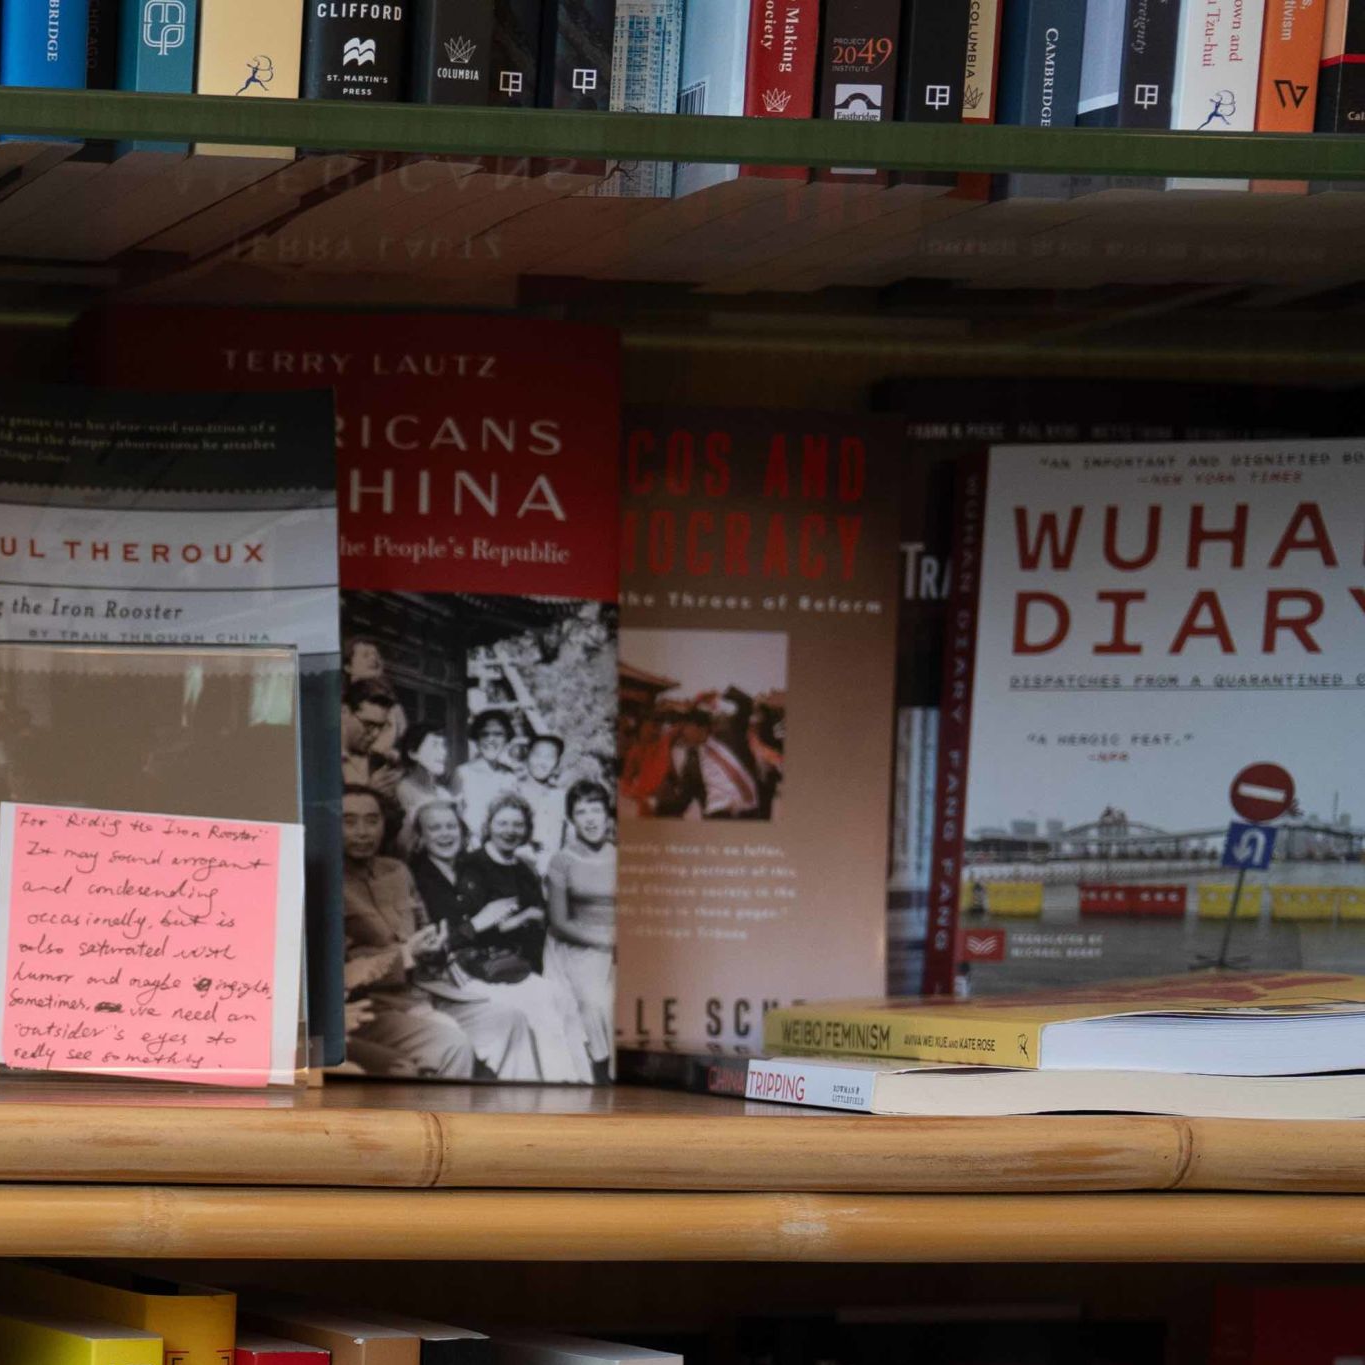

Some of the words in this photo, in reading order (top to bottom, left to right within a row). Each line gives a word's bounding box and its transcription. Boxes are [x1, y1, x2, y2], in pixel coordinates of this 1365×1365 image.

[317, 2, 402, 21] CLIFFORD
[832, 38, 892, 72] 2049
[327, 74, 342, 84] ST.
[344, 74, 388, 86] MARTIN'S
[1041, 26, 1060, 128] CAMBRIDGE
[343, 86, 372, 96] PRESS
[221, 349, 352, 375] TERRY
[374, 353, 497, 378] LAUTZ
[63, 540, 264, 564] THEROUX
[11, 597, 42, 615] the
[52, 599, 95, 618] Iron
[105, 602, 182, 621] Rooster
[66, 849, 98, 873] may
[782, 1021, 823, 1047] WEIBO
[825, 1022, 892, 1052] FEMINISM
